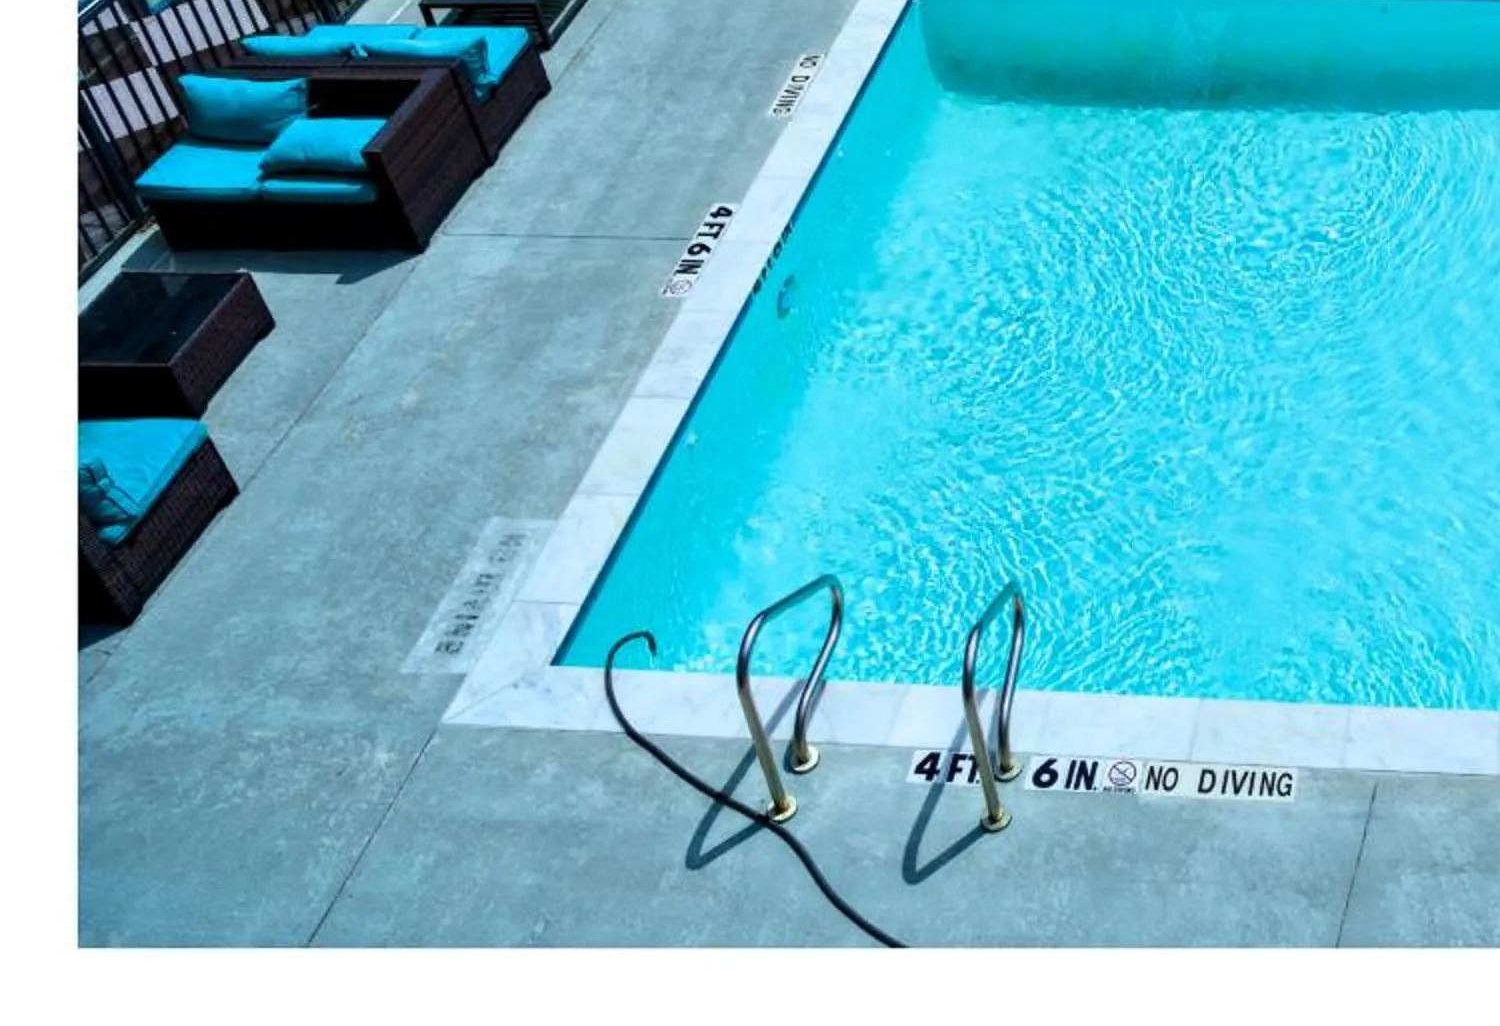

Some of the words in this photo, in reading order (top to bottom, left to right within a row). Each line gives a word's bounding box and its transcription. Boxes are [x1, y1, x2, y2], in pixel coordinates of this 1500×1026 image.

[772, 75, 811, 114] DIVING
[709, 205, 733, 219] 4
[687, 242, 712, 256] 6
[1031, 757, 1059, 789] 6
[1144, 765, 1180, 792] NO
[1196, 768, 1294, 797] DIVING
